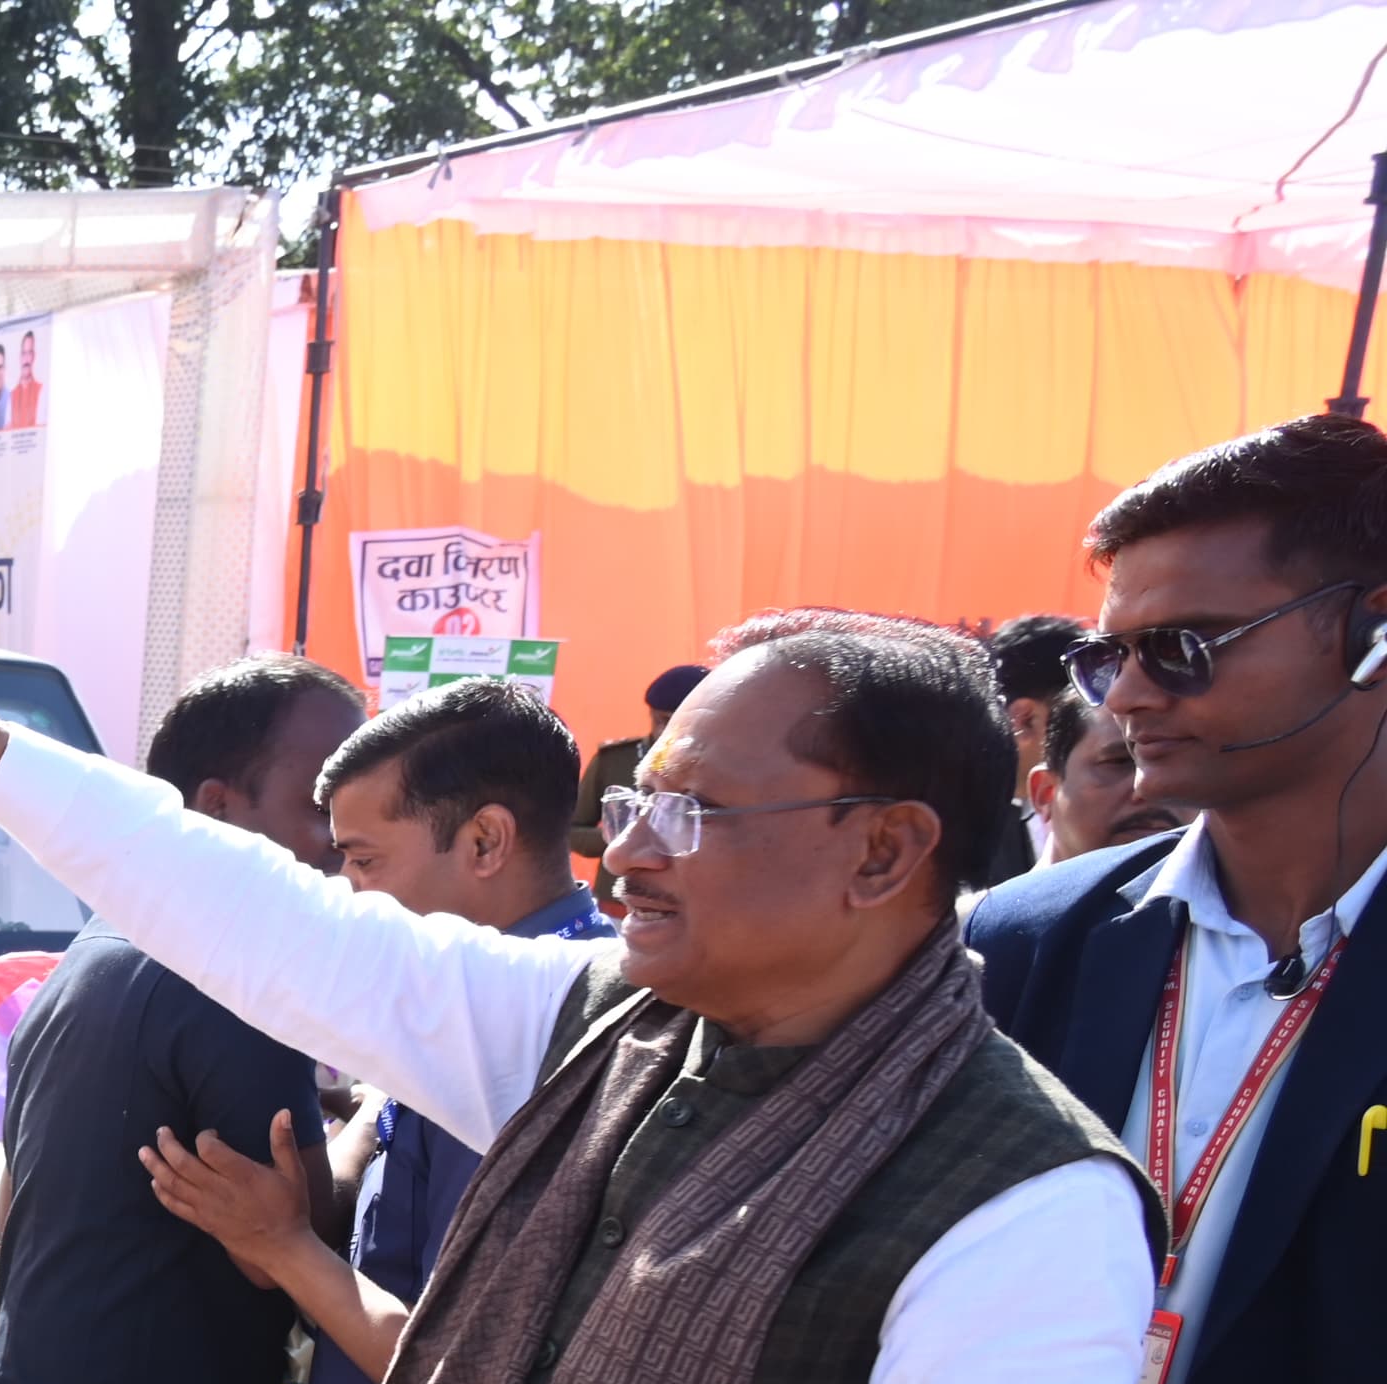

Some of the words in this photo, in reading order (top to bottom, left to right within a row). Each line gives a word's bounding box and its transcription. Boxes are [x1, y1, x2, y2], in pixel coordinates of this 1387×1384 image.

[377, 553, 434, 581] दवा
[1158, 1000, 1175, 1078] SECURITY
[1254, 999, 1309, 1077] SECURITY
[1182, 1087, 1252, 1206] CHHATTISGARH
